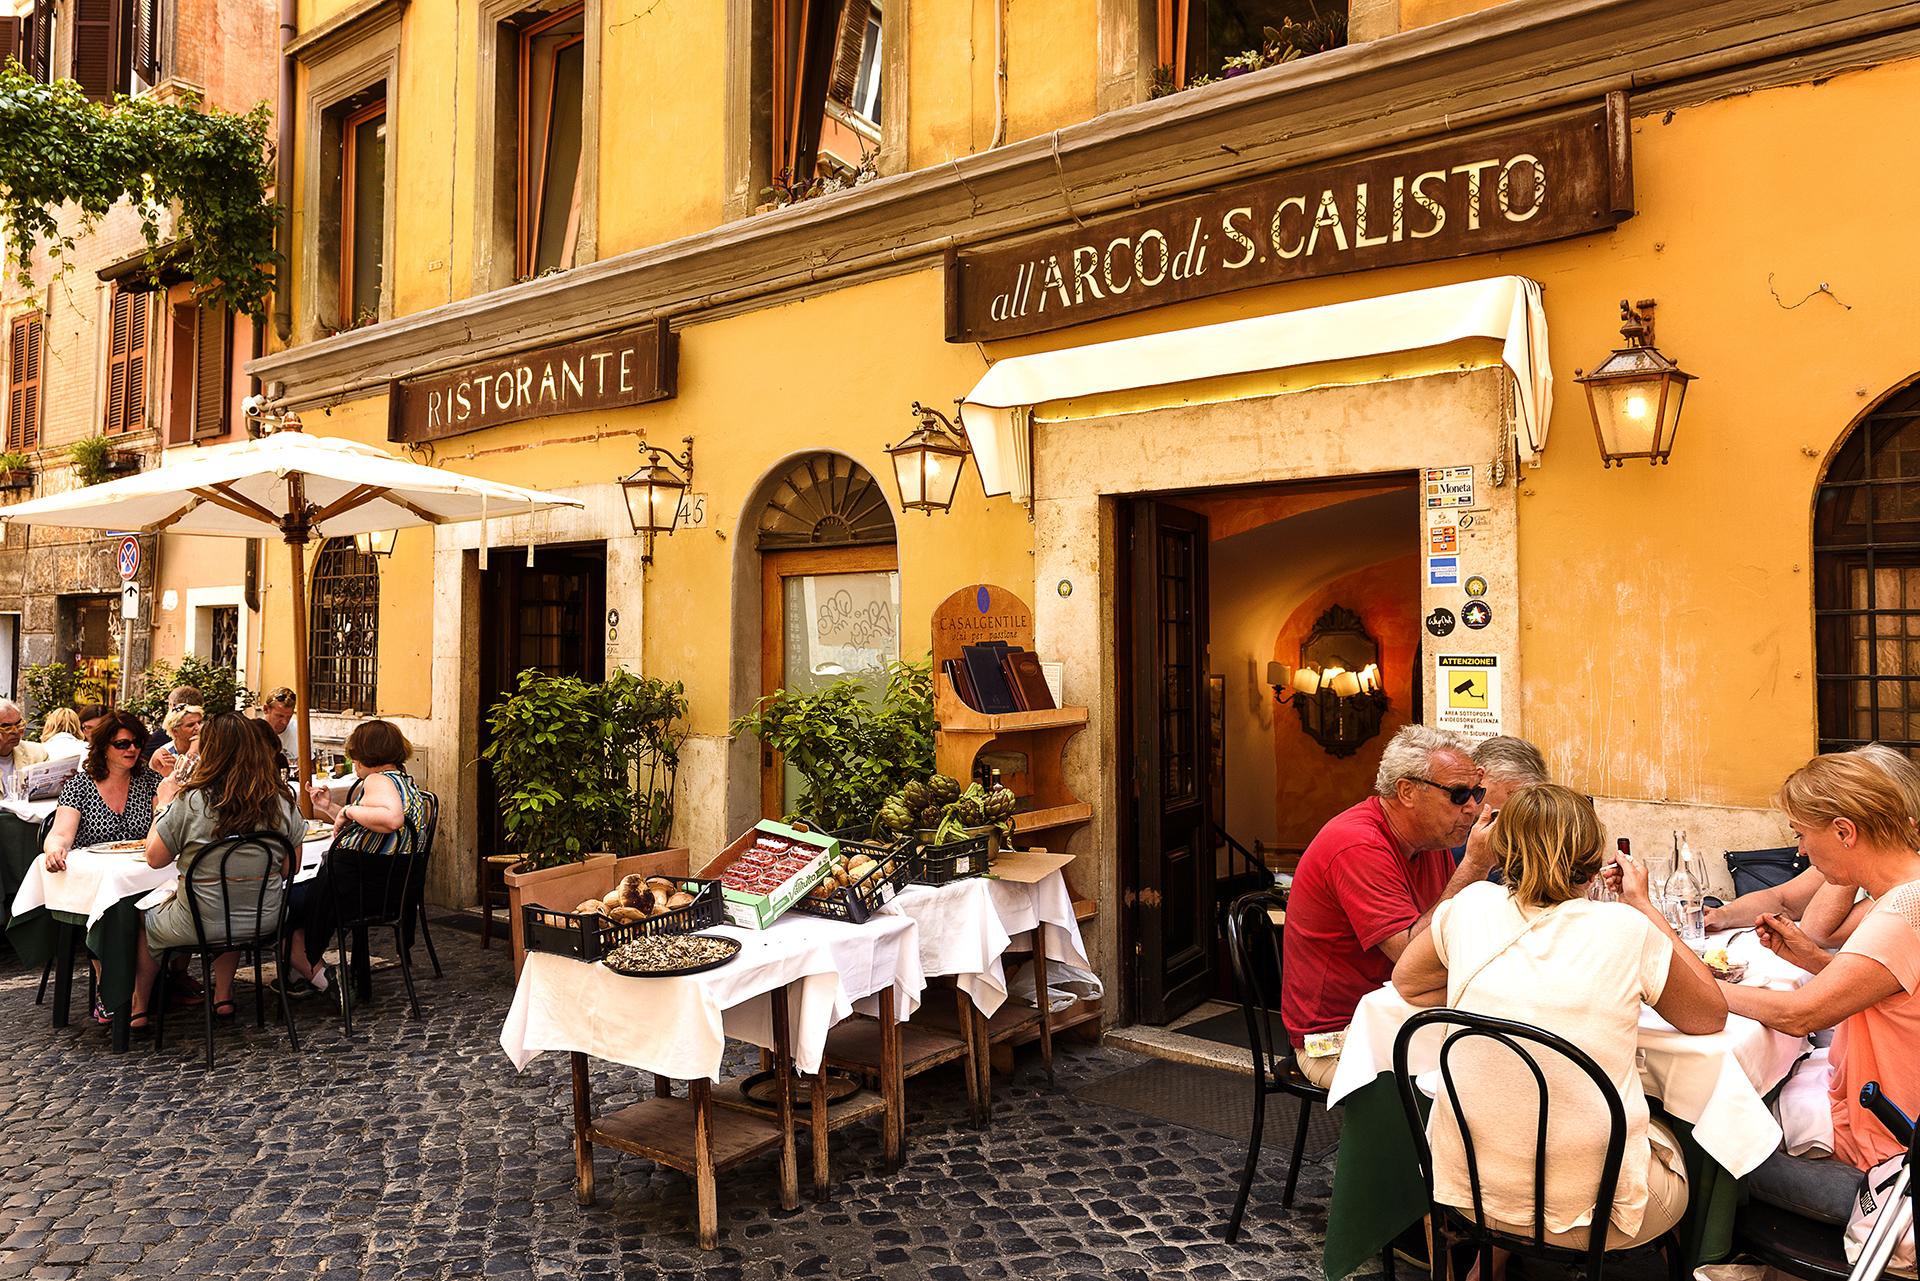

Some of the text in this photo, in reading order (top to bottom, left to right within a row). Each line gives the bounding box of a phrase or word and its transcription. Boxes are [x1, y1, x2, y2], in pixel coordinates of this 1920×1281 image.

[1171, 216, 1208, 281] di
[427, 349, 635, 428] RISTORANTE
[1440, 483, 1471, 494] Moneta
[678, 498, 704, 525] 45
[940, 615, 1027, 630] CASALGENTILE
[1442, 658, 1494, 666] ATTENZIONE!
